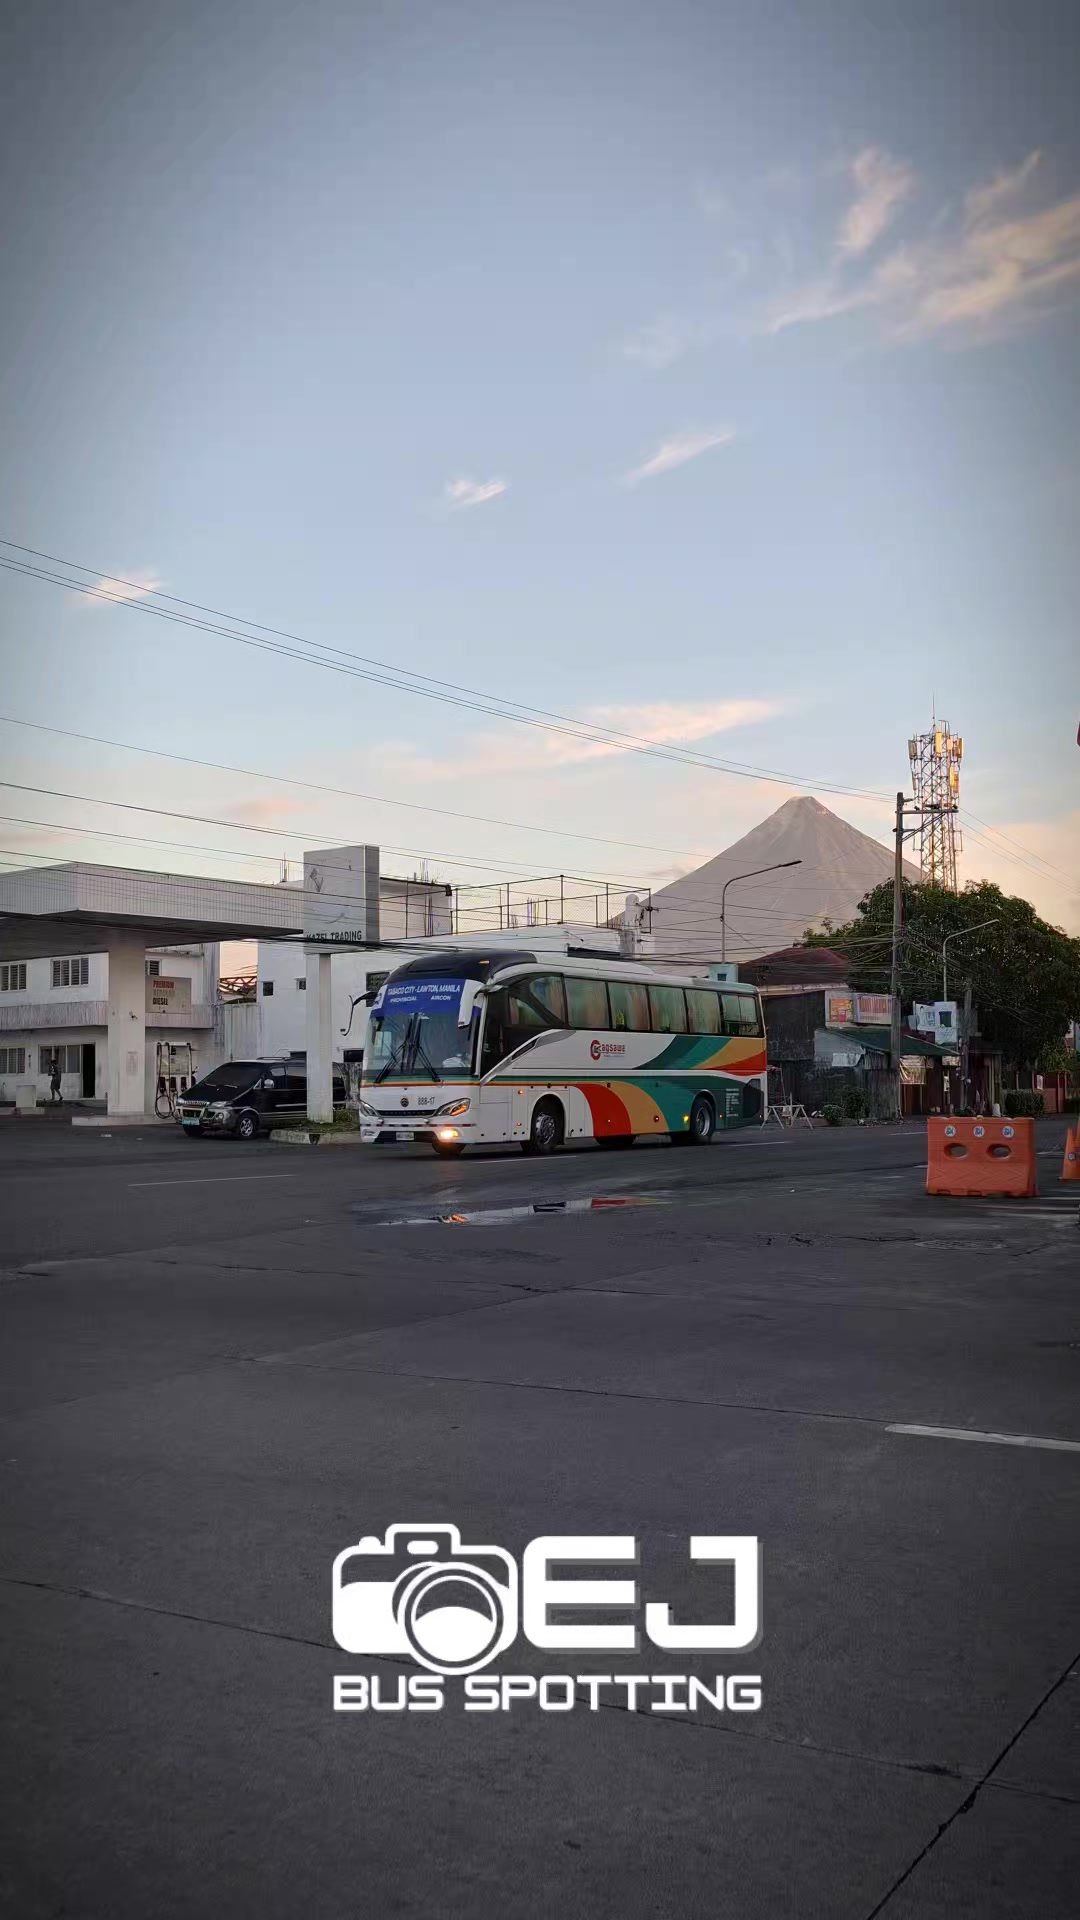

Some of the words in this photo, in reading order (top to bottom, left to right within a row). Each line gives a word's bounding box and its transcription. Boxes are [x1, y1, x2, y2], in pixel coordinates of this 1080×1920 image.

[330, 930, 362, 941] TRADING
[388, 986, 404, 996] TABACO
[404, 985, 415, 994] CITY
[439, 984, 461, 993] MANILA
[152, 997, 168, 1005] DIESEL
